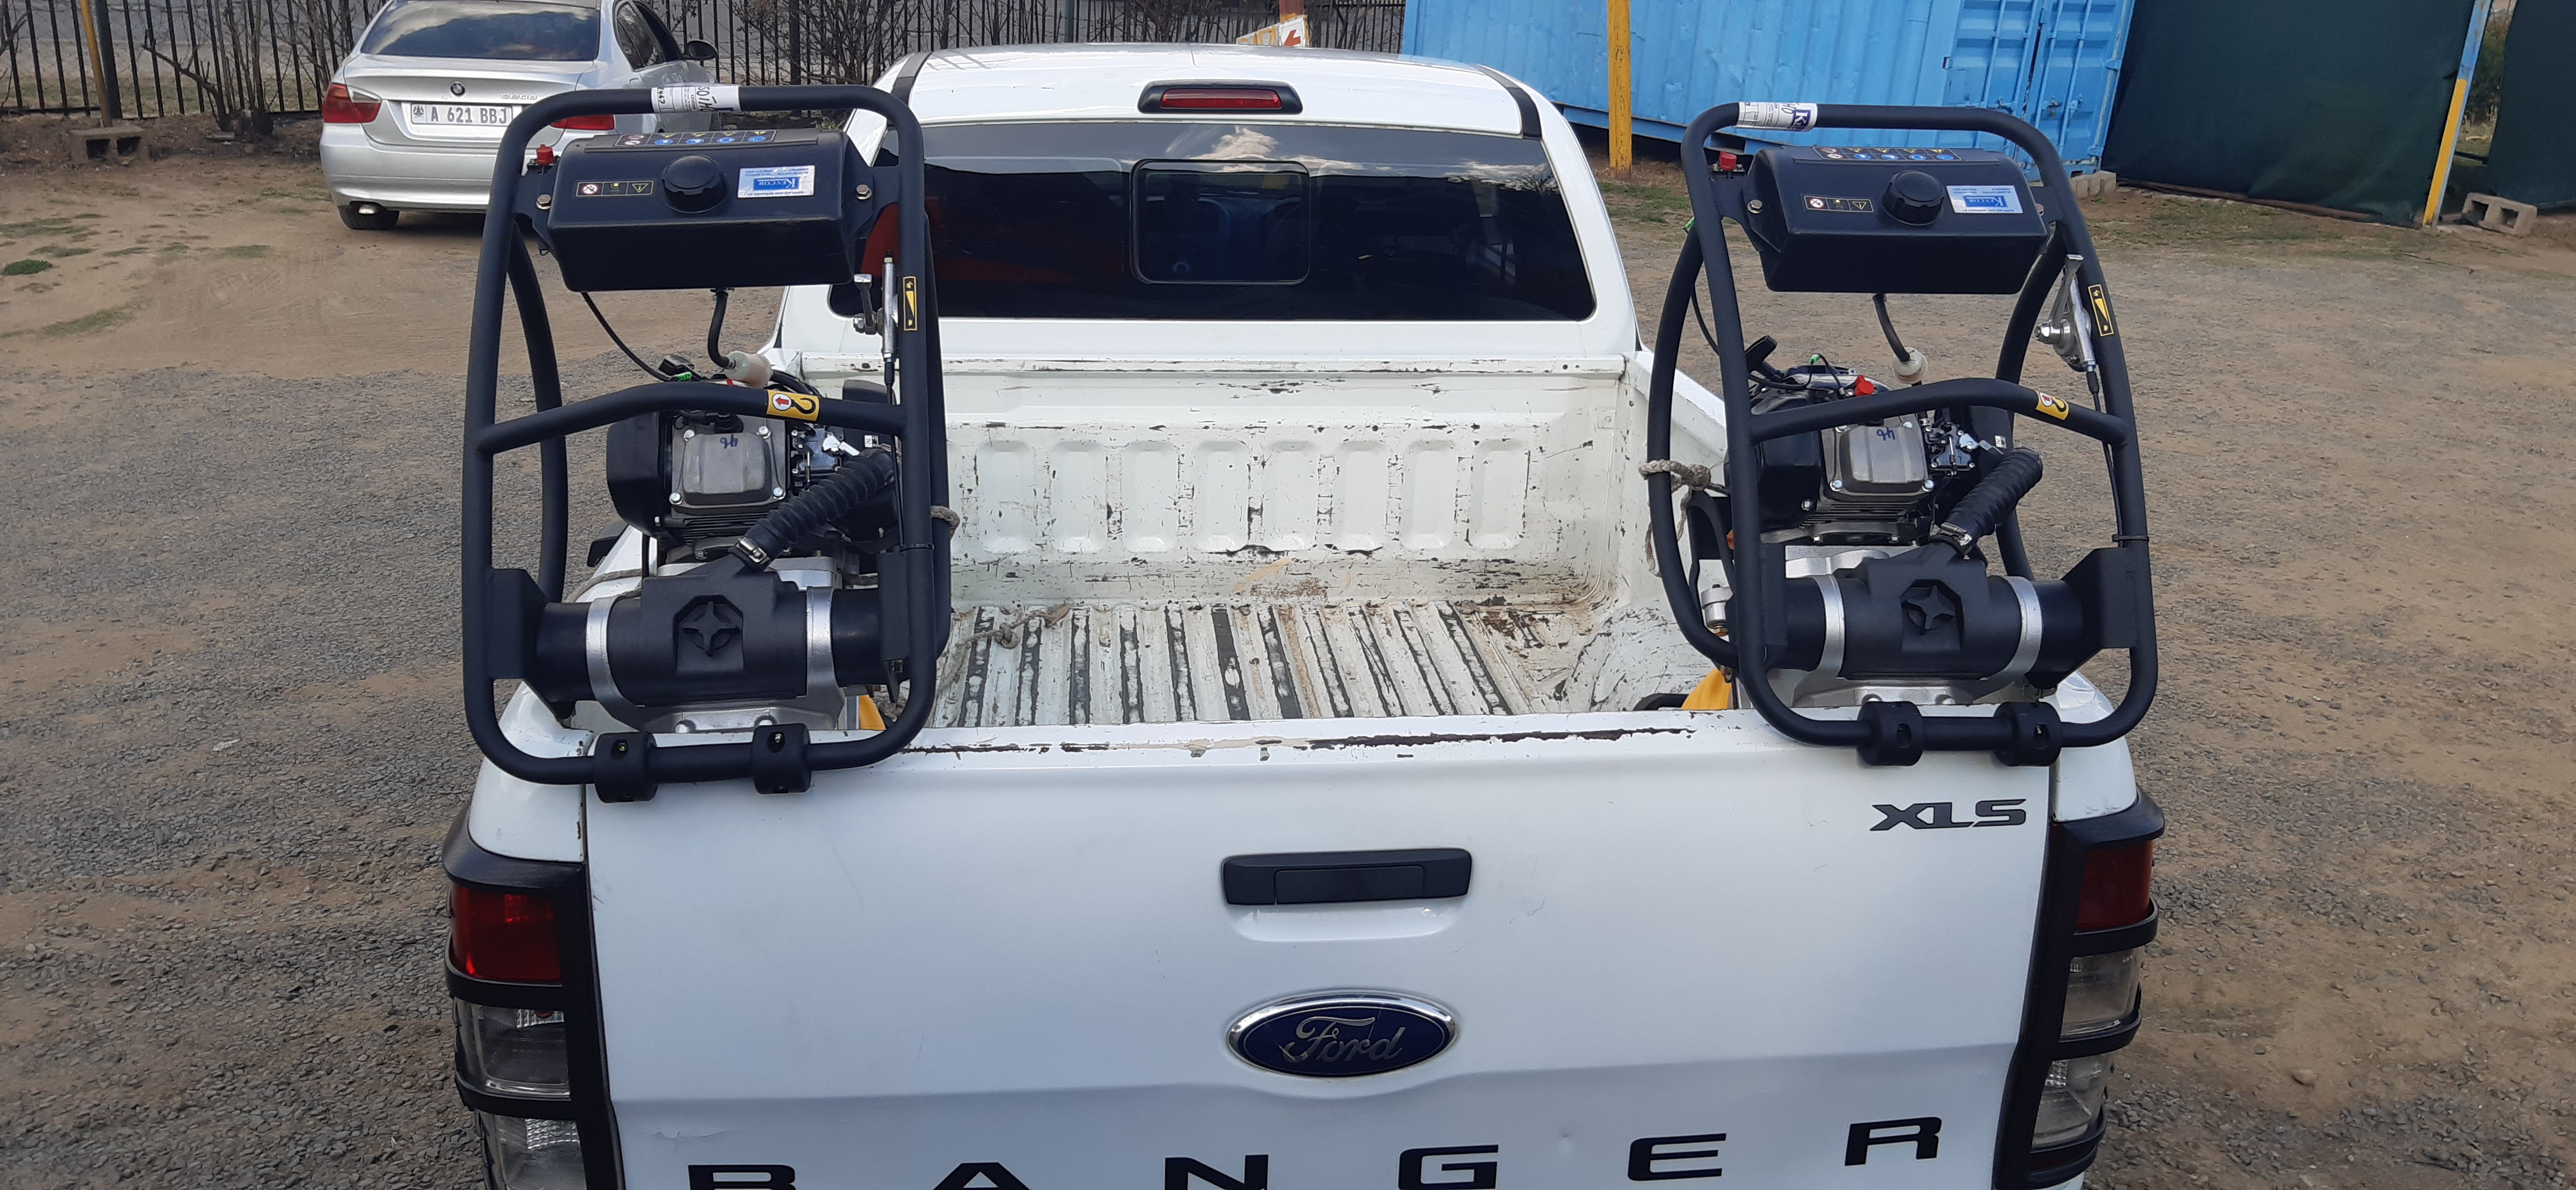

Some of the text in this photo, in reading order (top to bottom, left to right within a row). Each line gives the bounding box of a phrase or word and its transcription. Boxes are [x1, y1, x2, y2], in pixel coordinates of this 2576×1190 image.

[430, 106, 507, 124] A 621 BBJ
[756, 178, 797, 188] KEVCOR
[1966, 196, 2004, 206] KEVCOR
[1869, 799, 2026, 831] XLS
[1278, 1016, 1406, 1062] Ford
[688, 1117, 1942, 1190] RANGER
